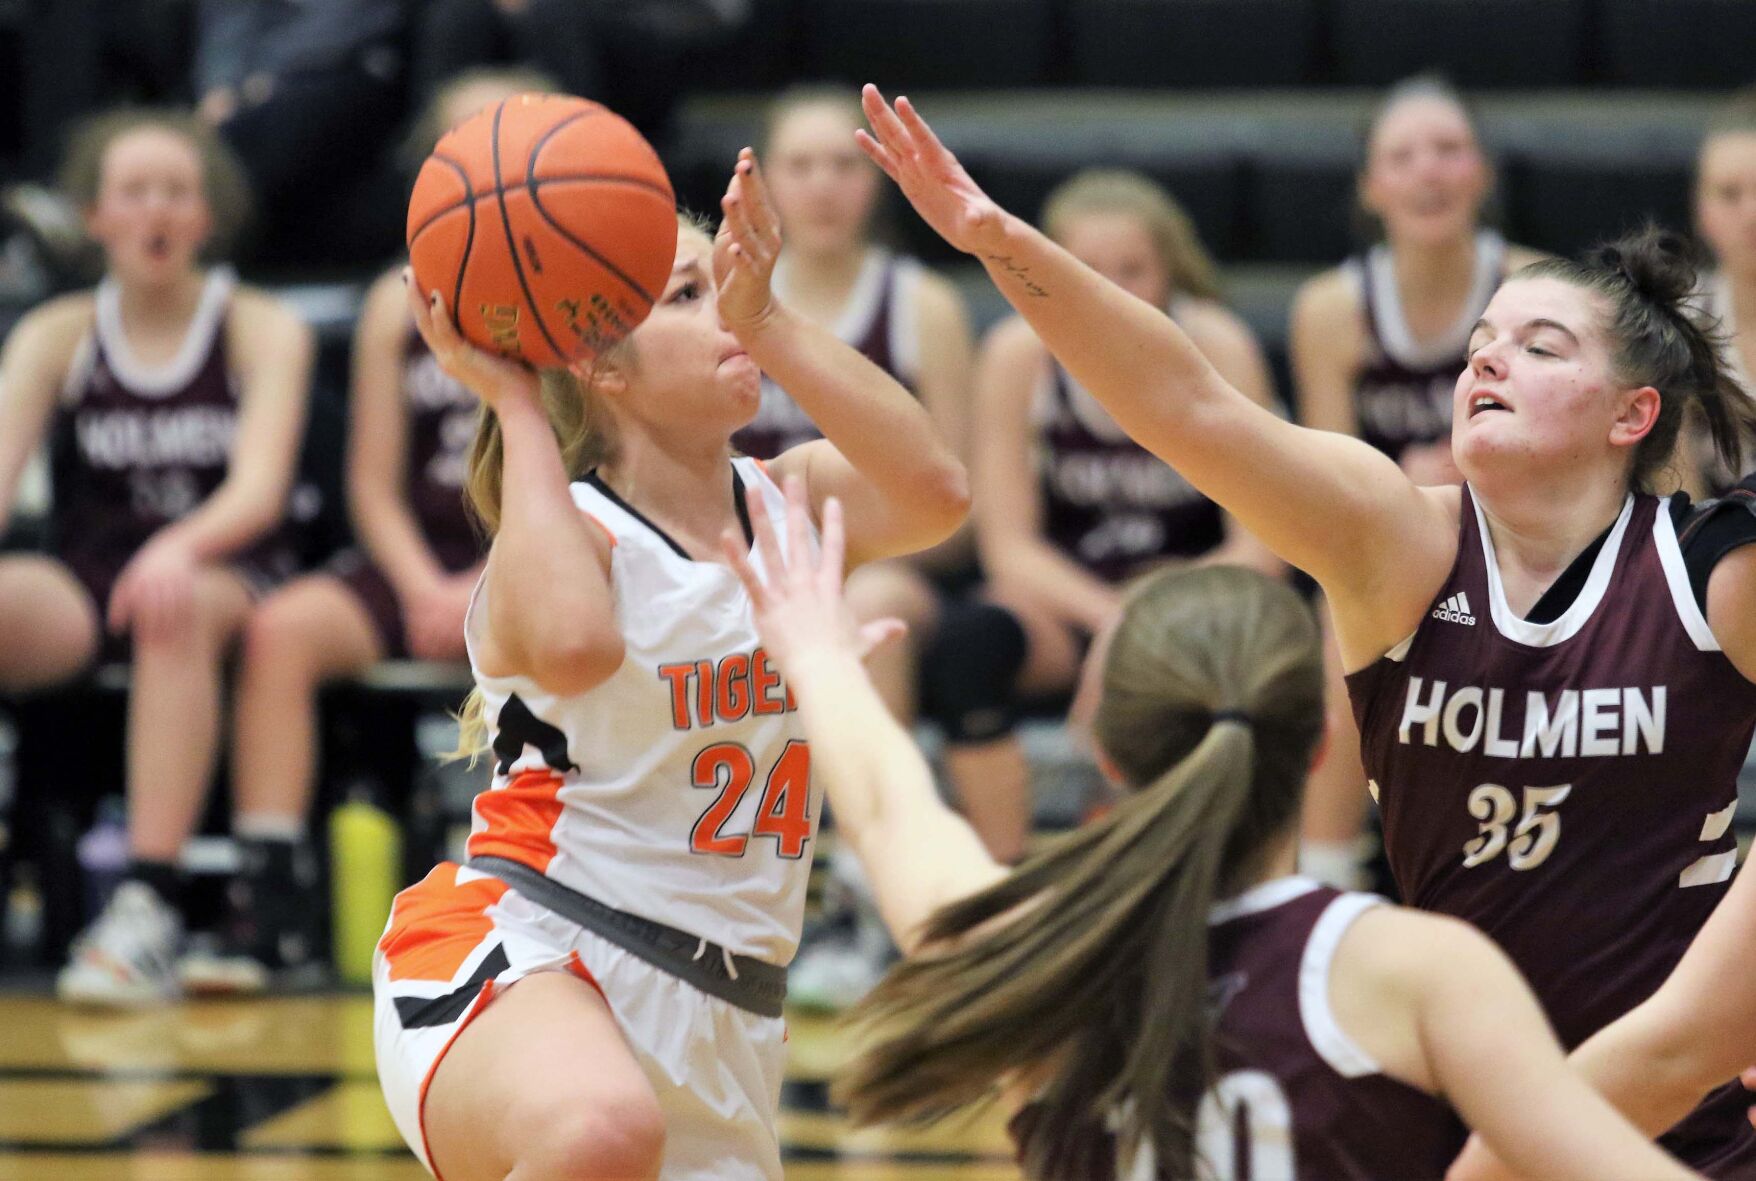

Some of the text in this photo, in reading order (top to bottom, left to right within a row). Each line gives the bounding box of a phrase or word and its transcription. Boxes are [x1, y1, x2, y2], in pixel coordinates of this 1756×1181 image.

[1432, 609, 1476, 626] adidas
[658, 648, 798, 730] TIGE
[1399, 676, 1667, 759] HOLMEN
[689, 739, 811, 860] 24
[1462, 783, 1572, 872] 35
